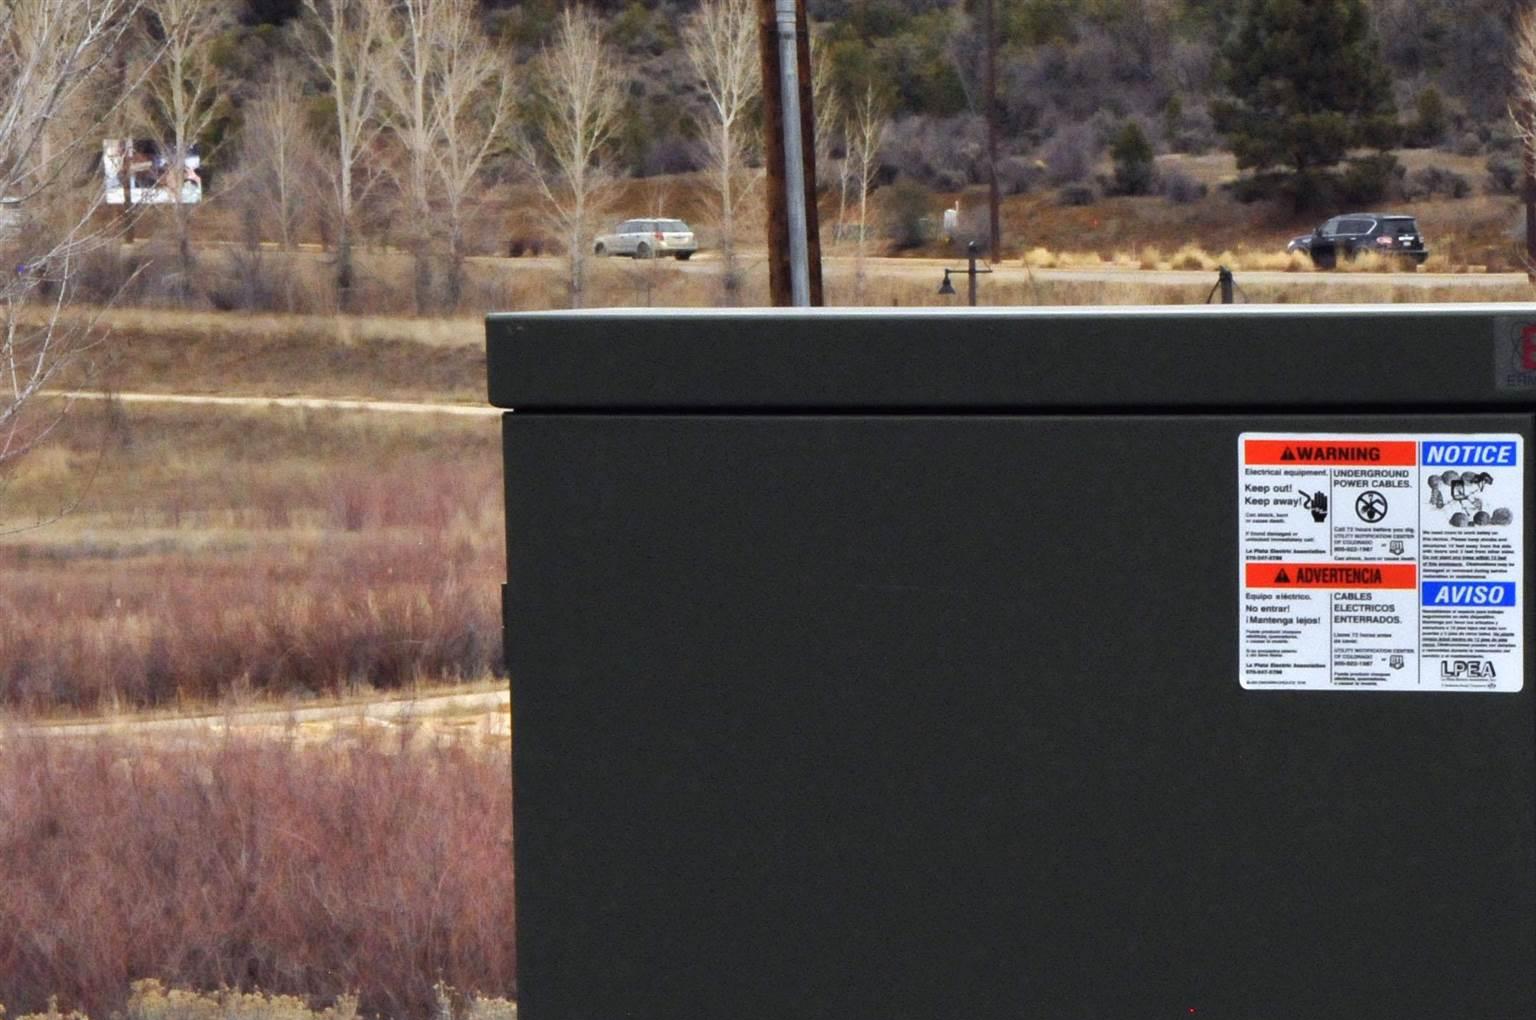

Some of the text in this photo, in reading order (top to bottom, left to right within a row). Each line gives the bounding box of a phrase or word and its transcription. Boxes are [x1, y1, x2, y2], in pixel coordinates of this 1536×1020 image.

[1297, 447, 1380, 462] WARNING
[1427, 445, 1511, 463] NOTICE
[1245, 468, 1328, 477] Electrical equipment.
[1333, 469, 1409, 478] UNDERGROUND
[1333, 480, 1413, 488] POWER CABLES.
[1245, 484, 1292, 494] Keep out!
[1245, 496, 1302, 508] Keep away!
[1296, 568, 1382, 584] ADVERTENCIA
[1334, 592, 1372, 600] CABLES
[1435, 585, 1504, 604] AVISO
[1245, 604, 1290, 612] No entrar!
[1334, 604, 1395, 612] ELECTRICOS
[1296, 616, 1320, 625] lejos!
[1334, 616, 1402, 624] ENTERRADOS.
[1440, 660, 1496, 678] LPEA
